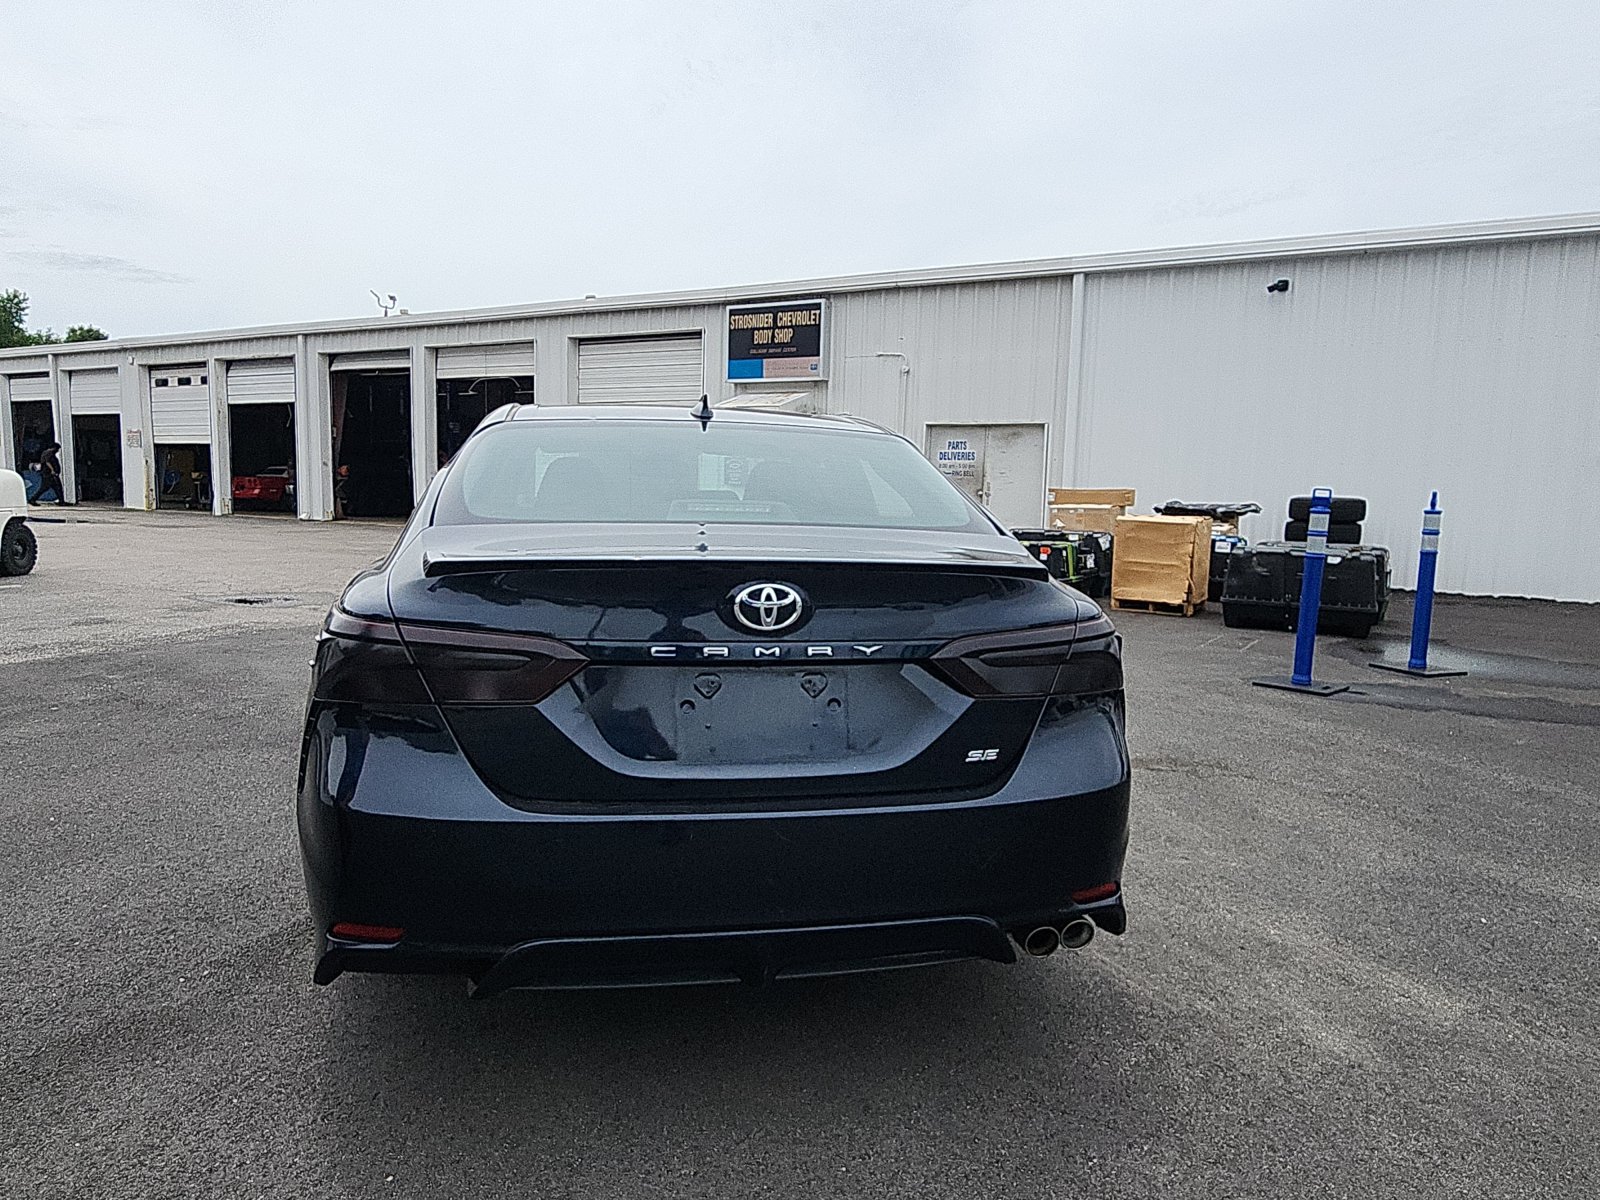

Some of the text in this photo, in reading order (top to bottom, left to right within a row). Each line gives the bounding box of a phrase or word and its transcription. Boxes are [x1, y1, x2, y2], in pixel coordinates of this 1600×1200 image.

[730, 309, 820, 330] STROSNIDER CHEVROLET
[753, 328, 793, 345] BODY SHOP
[948, 441, 967, 450] PARTS
[939, 451, 976, 461] DELIVERIES
[650, 645, 883, 657] CAMRY
[965, 748, 1000, 762] SE
